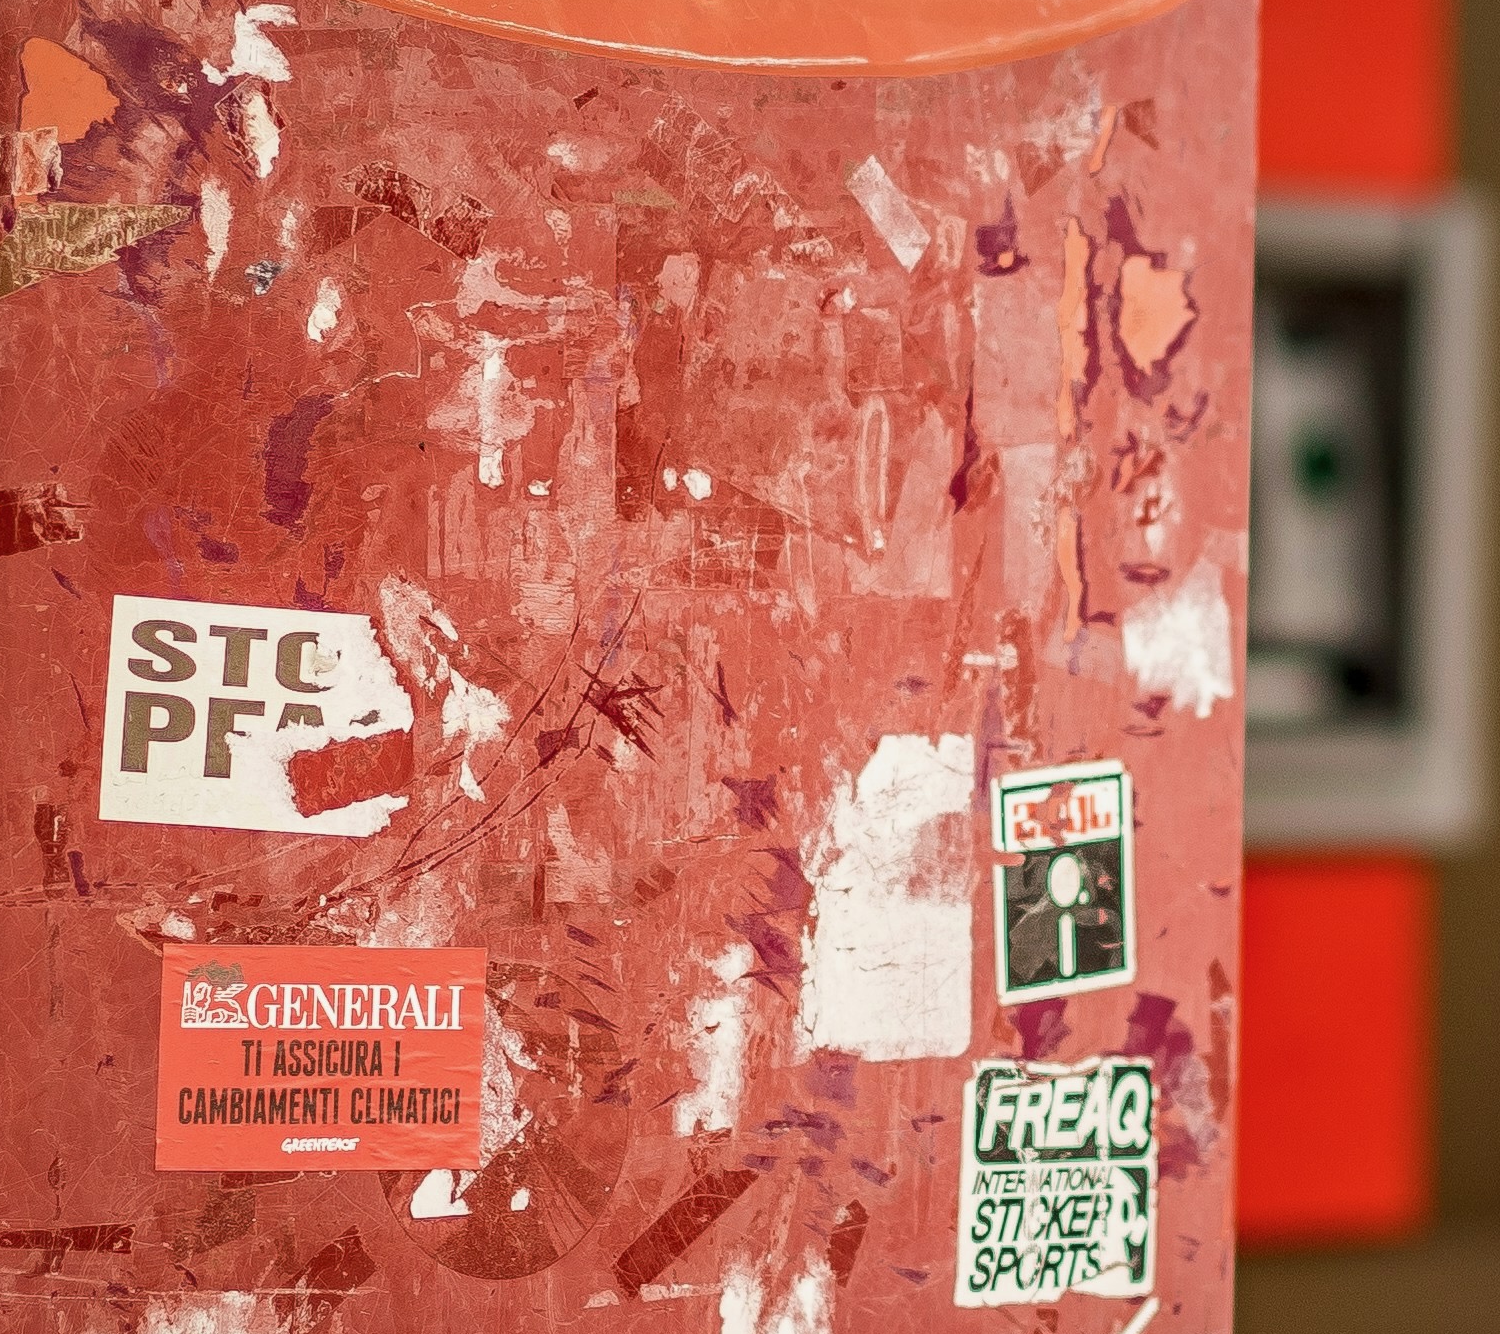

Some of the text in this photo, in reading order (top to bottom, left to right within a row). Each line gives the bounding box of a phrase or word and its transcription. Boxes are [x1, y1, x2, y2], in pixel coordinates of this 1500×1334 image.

[126, 618, 336, 694] STO
[245, 983, 465, 1031] GENERALI
[241, 1039, 402, 1078] TI ASSICURA I
[177, 1086, 461, 1126] CAMBIAMENTI CLIMATICI
[978, 1068, 1151, 1152] FREAQ
[280, 1136, 361, 1155] GREENPEACE
[971, 1166, 1116, 1196] INTERNATIONAL
[970, 1192, 1114, 1244] STICKER
[968, 1241, 1106, 1293] SPORTS
